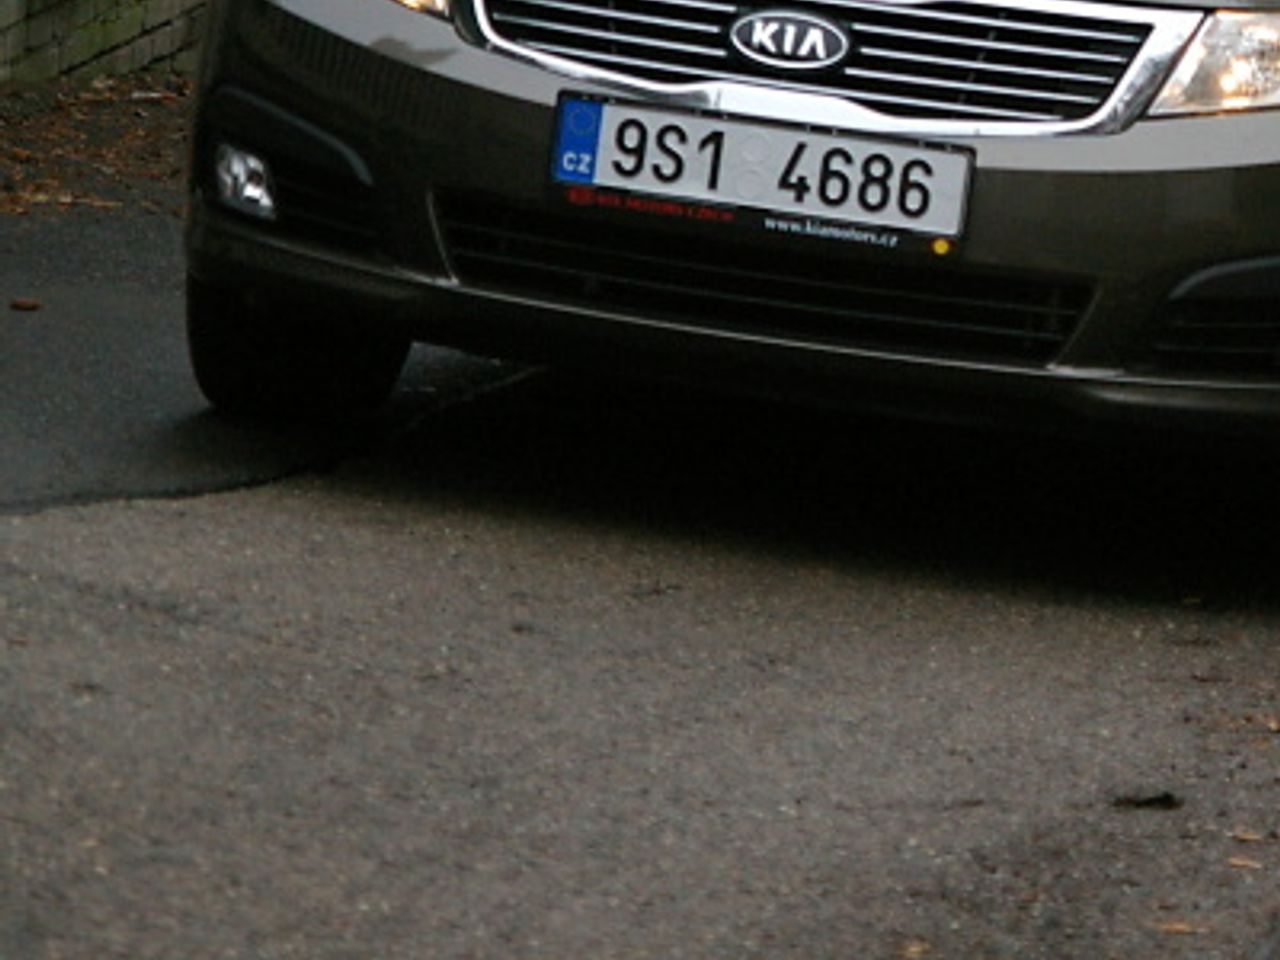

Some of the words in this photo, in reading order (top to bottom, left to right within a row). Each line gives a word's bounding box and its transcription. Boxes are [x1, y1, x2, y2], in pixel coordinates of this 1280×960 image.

[750, 20, 827, 60] KIA
[562, 151, 592, 175] CZ
[611, 119, 726, 191] 9S1
[777, 142, 934, 219] 4686
